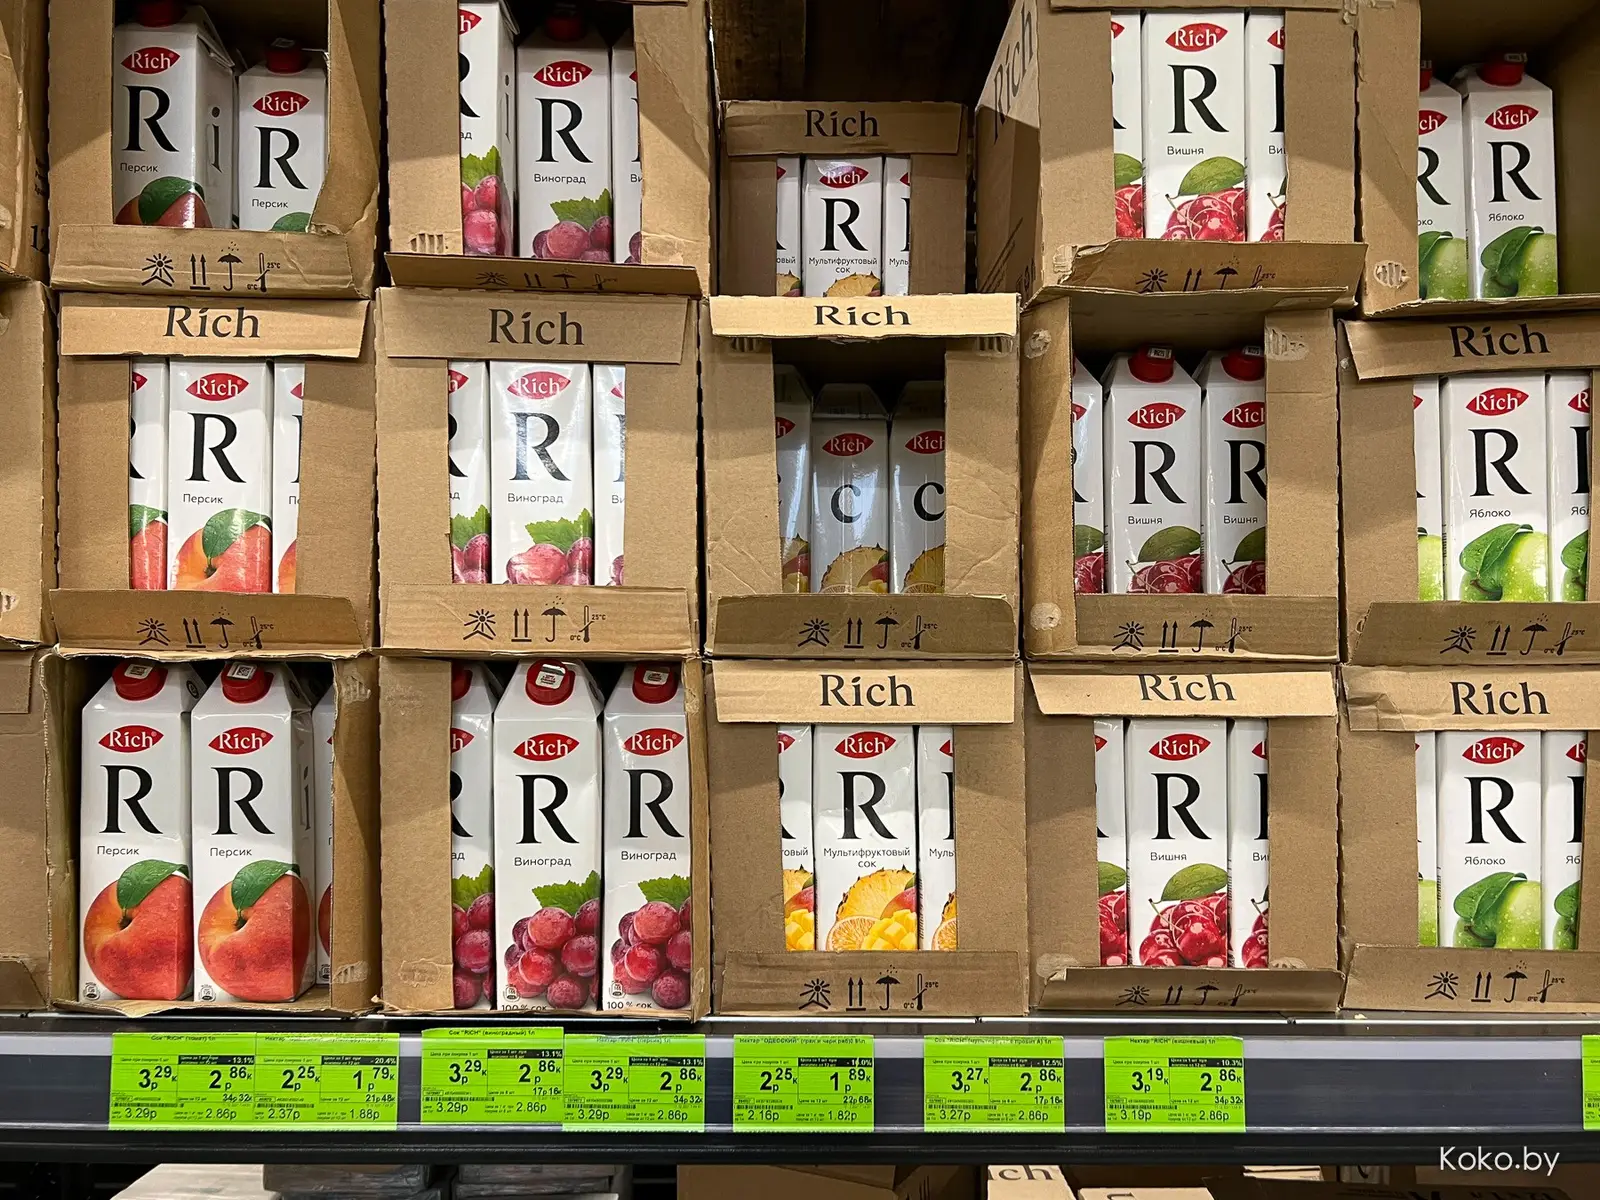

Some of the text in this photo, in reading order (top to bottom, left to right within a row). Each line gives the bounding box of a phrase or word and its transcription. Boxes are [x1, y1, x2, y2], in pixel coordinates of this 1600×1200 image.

[1175, 29, 1217, 47] Rich
[131, 52, 173, 70] Rich
[543, 66, 583, 82] Rich
[262, 96, 300, 112] Rich
[1168, 65, 1229, 133] R
[122, 85, 180, 152] R
[805, 110, 879, 136] Rich
[1492, 110, 1529, 126] Rich
[535, 98, 593, 163] R
[255, 127, 308, 189] R
[1168, 146, 1203, 155] Вишня
[120, 163, 158, 174] Персик
[1487, 142, 1541, 202] R
[534, 174, 586, 184] Виноград
[827, 171, 862, 185] Rich
[252, 199, 288, 209] Персик
[820, 198, 868, 251] R
[1489, 213, 1524, 221] Яблоко
[809, 257, 877, 266] Мультифруктовый
[164, 305, 260, 338] Rich
[814, 305, 911, 326] Rich
[488, 309, 585, 346] Rich
[1449, 323, 1550, 357] Rich
[197, 379, 239, 396] Rich
[517, 378, 560, 394] Rich
[1476, 394, 1518, 410] Rich
[1137, 408, 1177, 424] Rich
[187, 413, 246, 483] R
[509, 413, 570, 481] R
[830, 438, 865, 453] Rich
[1469, 429, 1531, 496] R
[1129, 441, 1186, 504] R
[184, 494, 223, 504] Персик
[508, 493, 563, 504] Виноград
[1128, 516, 1162, 524] Вишня
[1470, 509, 1510, 518] Яблоко
[820, 675, 915, 706] Rich
[1138, 674, 1237, 701] Rich
[1450, 682, 1550, 715] Rich
[109, 732, 152, 748] Rich
[219, 733, 262, 749] Rich
[524, 740, 568, 756] Rich
[631, 734, 673, 750] Rich
[844, 737, 887, 753] Rich
[1158, 739, 1200, 755] Rich
[1472, 742, 1515, 758] Rich
[100, 765, 163, 834] R
[213, 767, 275, 834] R
[623, 770, 684, 838] R
[837, 772, 897, 839] R
[1151, 773, 1211, 839] R
[516, 775, 579, 844] R
[1464, 777, 1526, 843] R
[97, 846, 139, 856] Персик
[210, 848, 252, 858] Персик
[622, 851, 676, 861] Виноград
[824, 848, 910, 858] Мультифруктовый
[1151, 852, 1186, 860] Вишня
[515, 857, 571, 867] Виноград
[1465, 857, 1505, 865] Яблоко
[607, 1001, 623, 1009] 100
[125, 1108, 157, 1120] 3.29р
[206, 1109, 237, 1120] 2.86р
[268, 1109, 300, 1120] 2.37р
[350, 1110, 380, 1120] 1.88р
[437, 1102, 468, 1114] 3.29р
[516, 1102, 547, 1113] 2.86р
[578, 1110, 609, 1121] 3.29р
[658, 1110, 688, 1121] 2.86р
[748, 1110, 779, 1122] 2.16р
[829, 1111, 857, 1122] 1.82р
[940, 1110, 970, 1122] 3.27р
[1019, 1111, 1048, 1122] 2.86р
[1120, 1110, 1151, 1122] 3.19р
[1199, 1110, 1229, 1122] 2.86р
